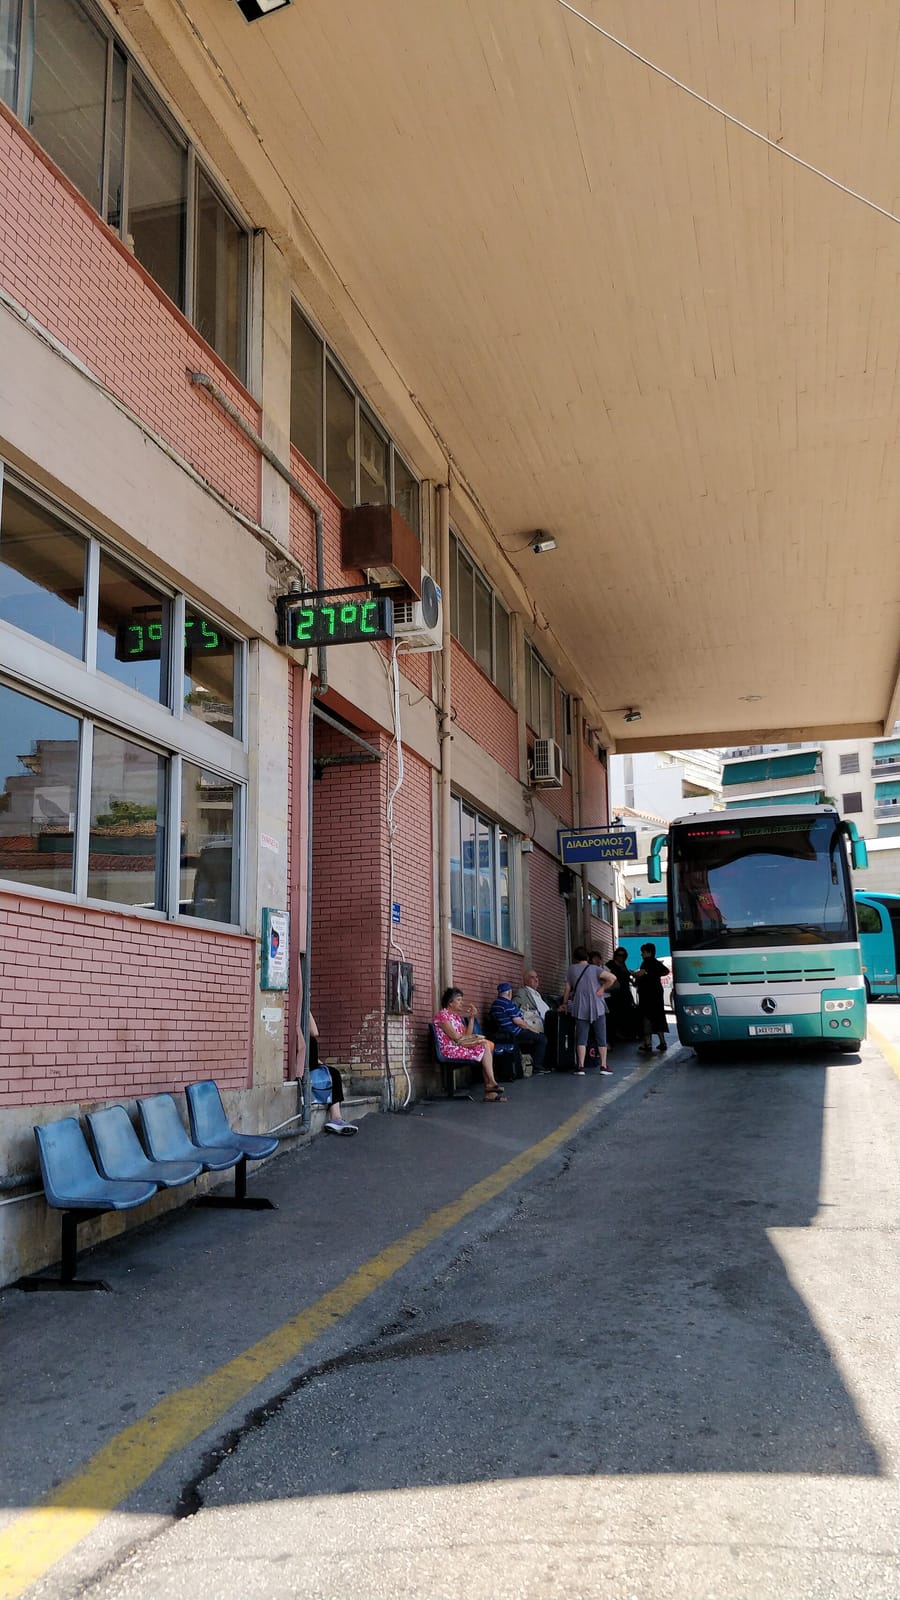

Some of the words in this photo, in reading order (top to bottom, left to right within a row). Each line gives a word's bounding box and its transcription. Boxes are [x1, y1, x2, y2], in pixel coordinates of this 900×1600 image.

[566, 837, 624, 849] ΔΙΑΔΡΟΜΟΣ
[624, 836, 634, 856] 2
[601, 848, 624, 857] LANE
